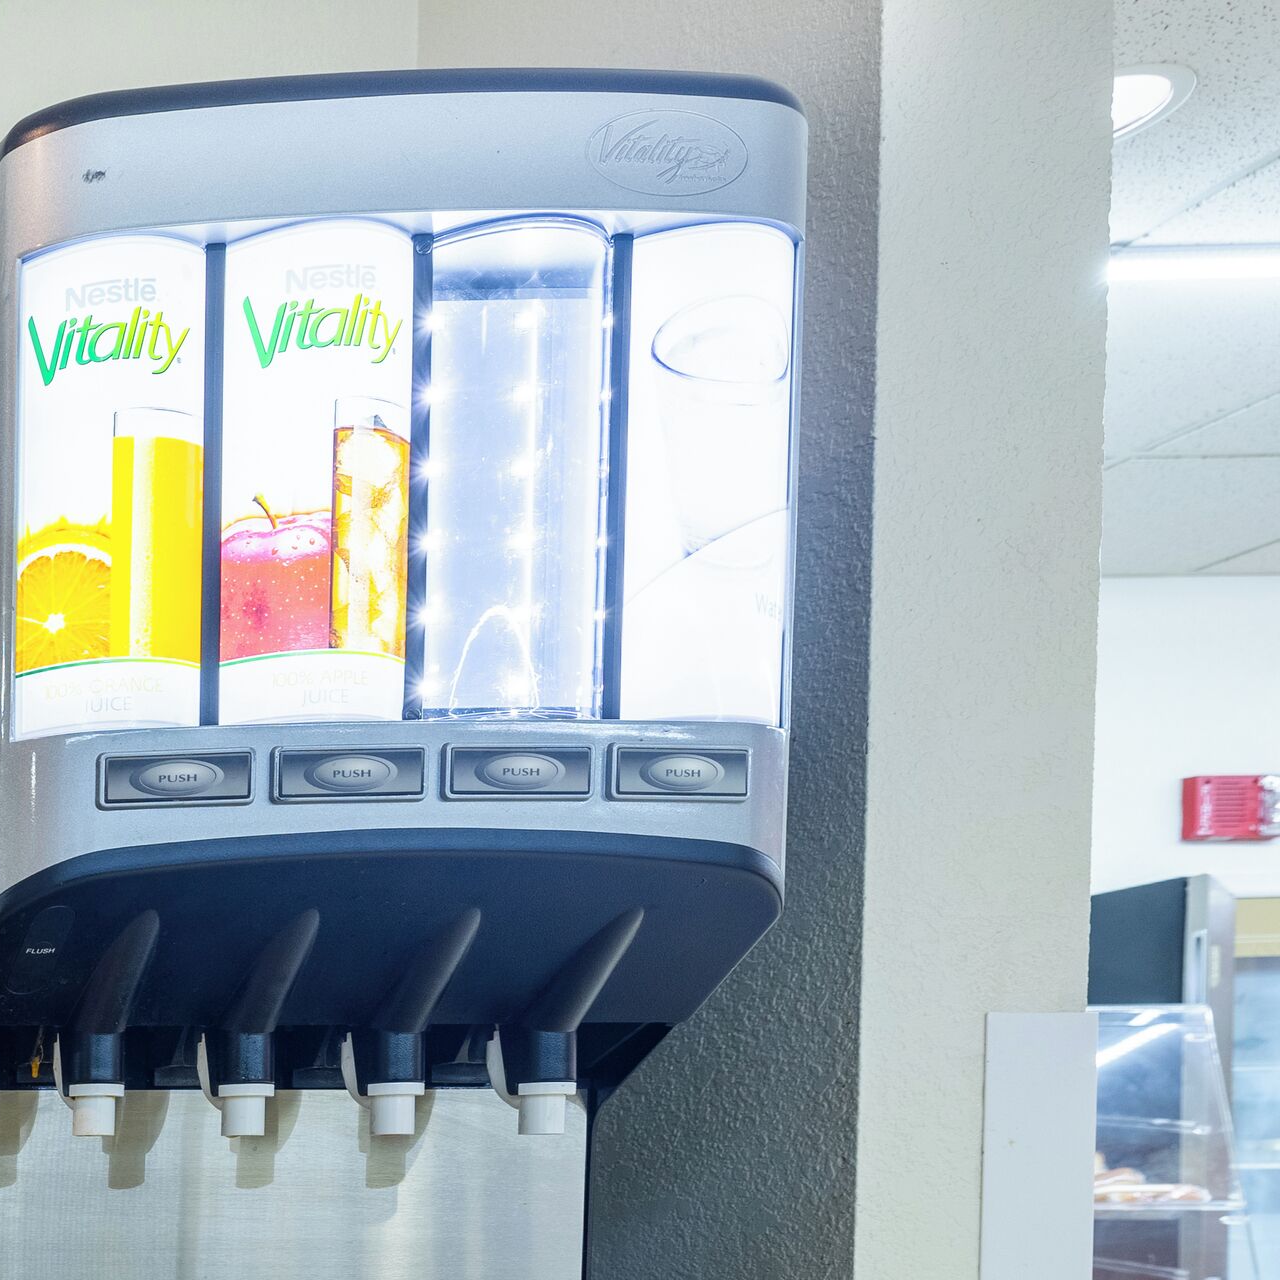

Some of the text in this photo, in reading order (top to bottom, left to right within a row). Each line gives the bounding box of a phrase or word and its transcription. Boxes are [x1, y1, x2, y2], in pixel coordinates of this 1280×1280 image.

[599, 119, 696, 184] Vitality
[242, 293, 403, 369] Vitality
[28, 306, 191, 387] Vitality
[89, 676, 165, 695] ORANGE
[320, 670, 369, 686] APPLE
[85, 696, 132, 713] JUICE
[302, 688, 349, 707] JUICE
[158, 771, 198, 785] PUSH
[332, 766, 372, 780] PUSH
[502, 764, 541, 778] PUSH
[665, 766, 702, 779] PUSH
[25, 947, 56, 955] FLUSH
